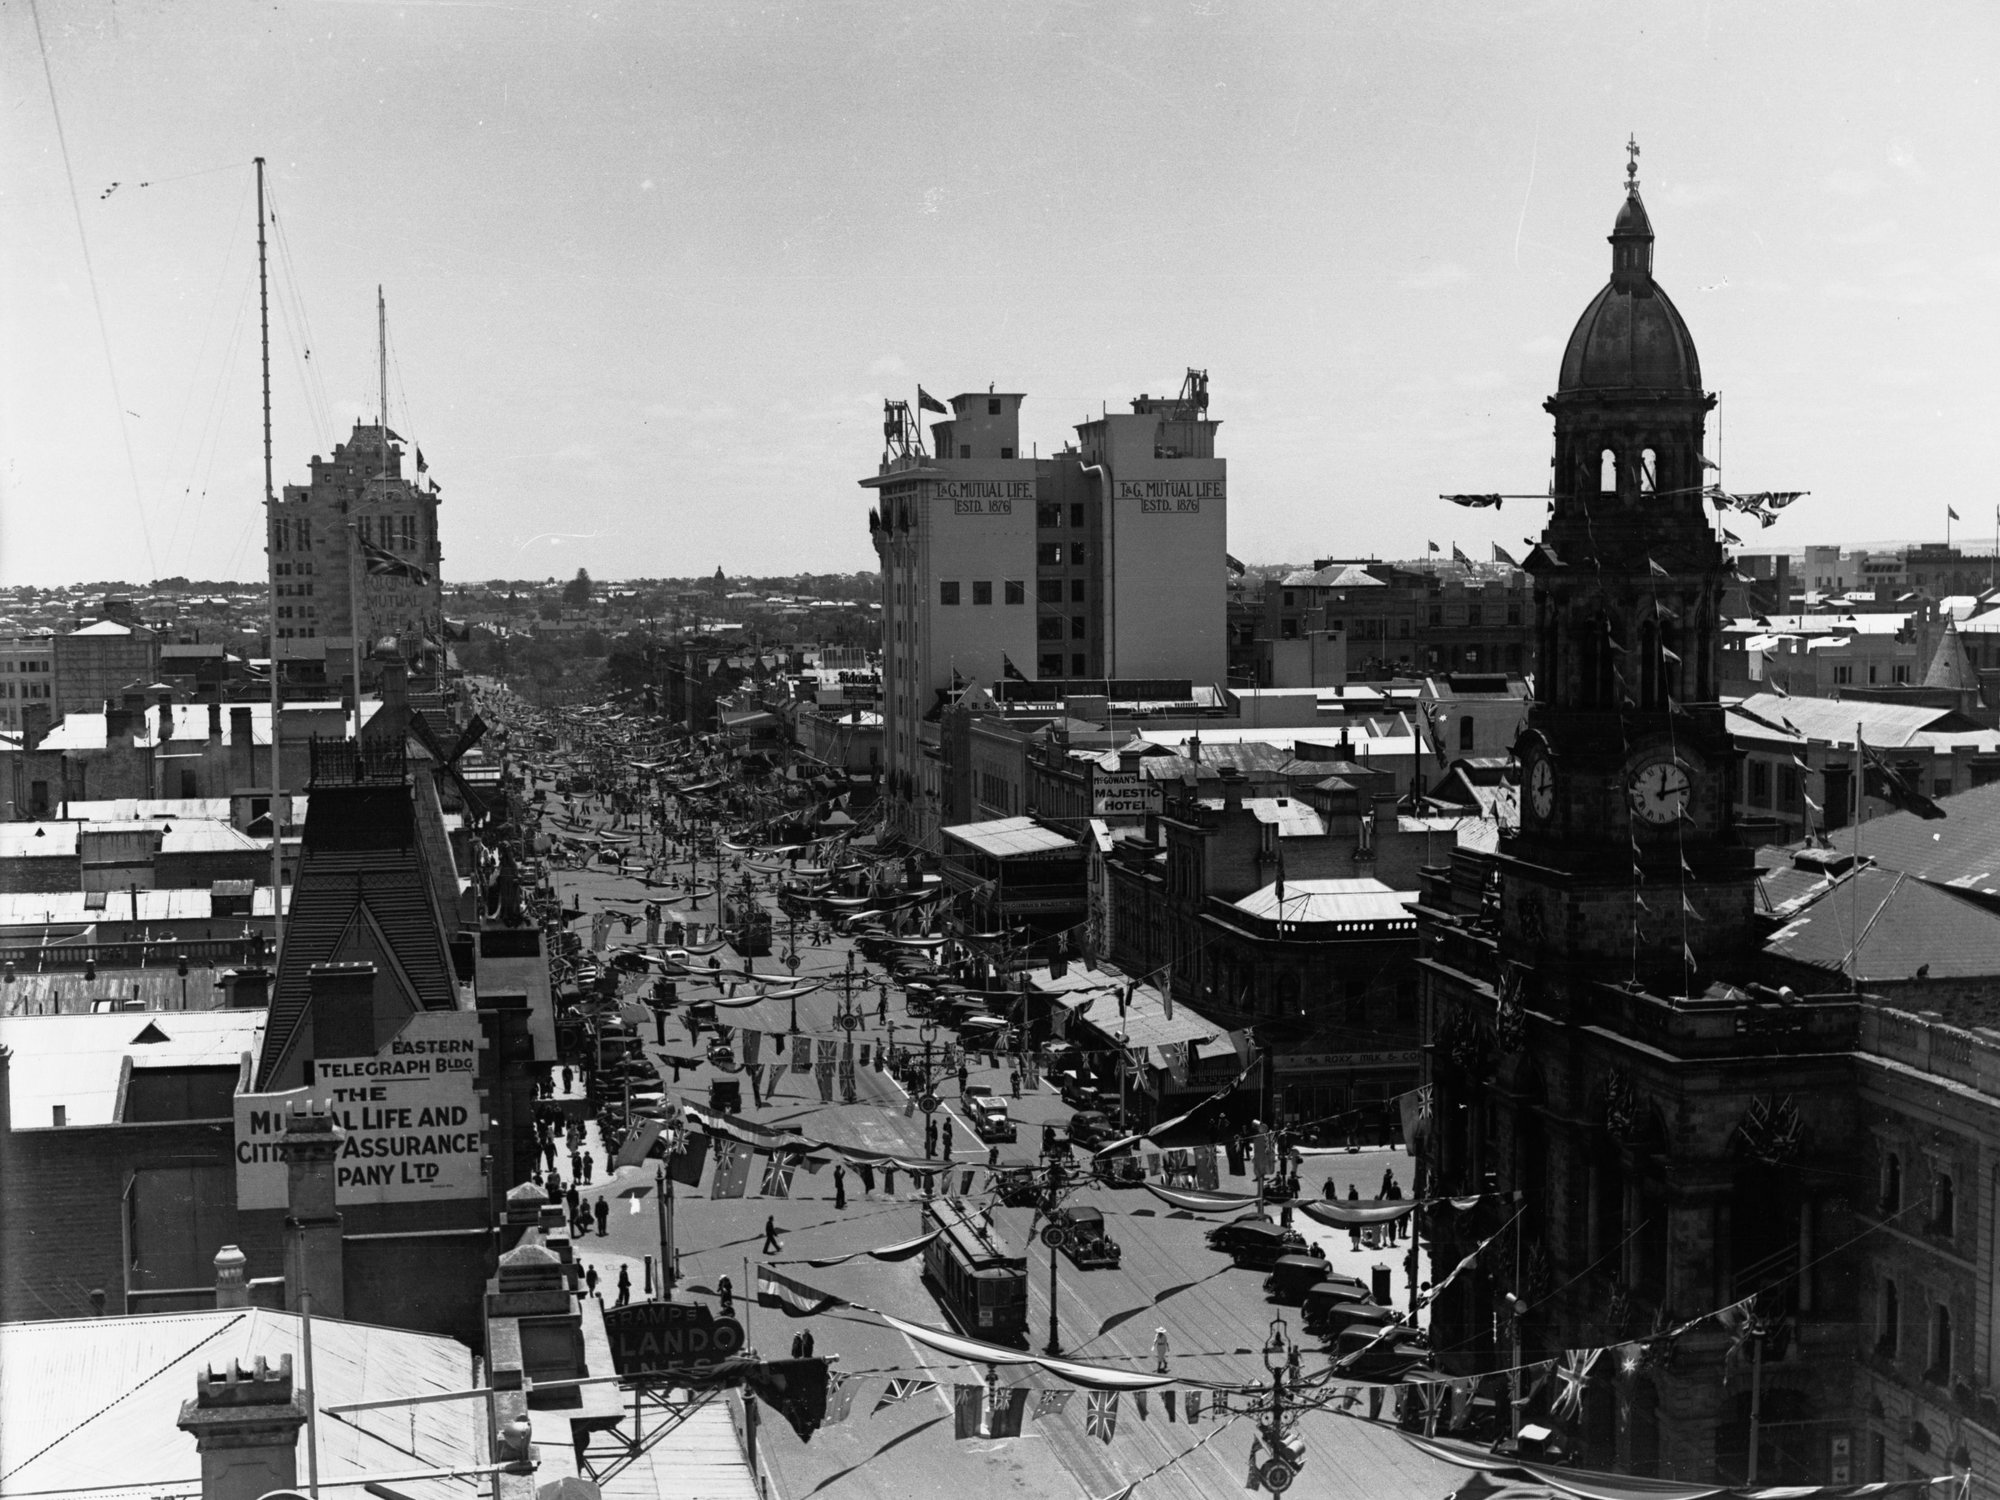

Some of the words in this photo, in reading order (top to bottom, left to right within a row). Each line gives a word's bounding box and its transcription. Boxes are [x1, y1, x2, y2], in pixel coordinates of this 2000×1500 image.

[960, 482, 1004, 498] MUTUAL
[1146, 482, 1194, 497] MUTUAL
[989, 500, 1010, 512] 1876
[1177, 499, 1198, 511] 1876
[366, 594, 420, 608] MUTUAL
[1094, 788, 1160, 798] MAJESTIC
[392, 1039, 474, 1055] EASTERN
[1325, 1054, 1353, 1064] ROXY
[318, 1059, 430, 1078] TELEGRAPH
[436, 1057, 474, 1074] BLDG.
[333, 1086, 387, 1102] THE
[362, 1106, 412, 1131] LIFE
[418, 1105, 468, 1127] AND
[342, 1133, 479, 1159] ASSURANCE
